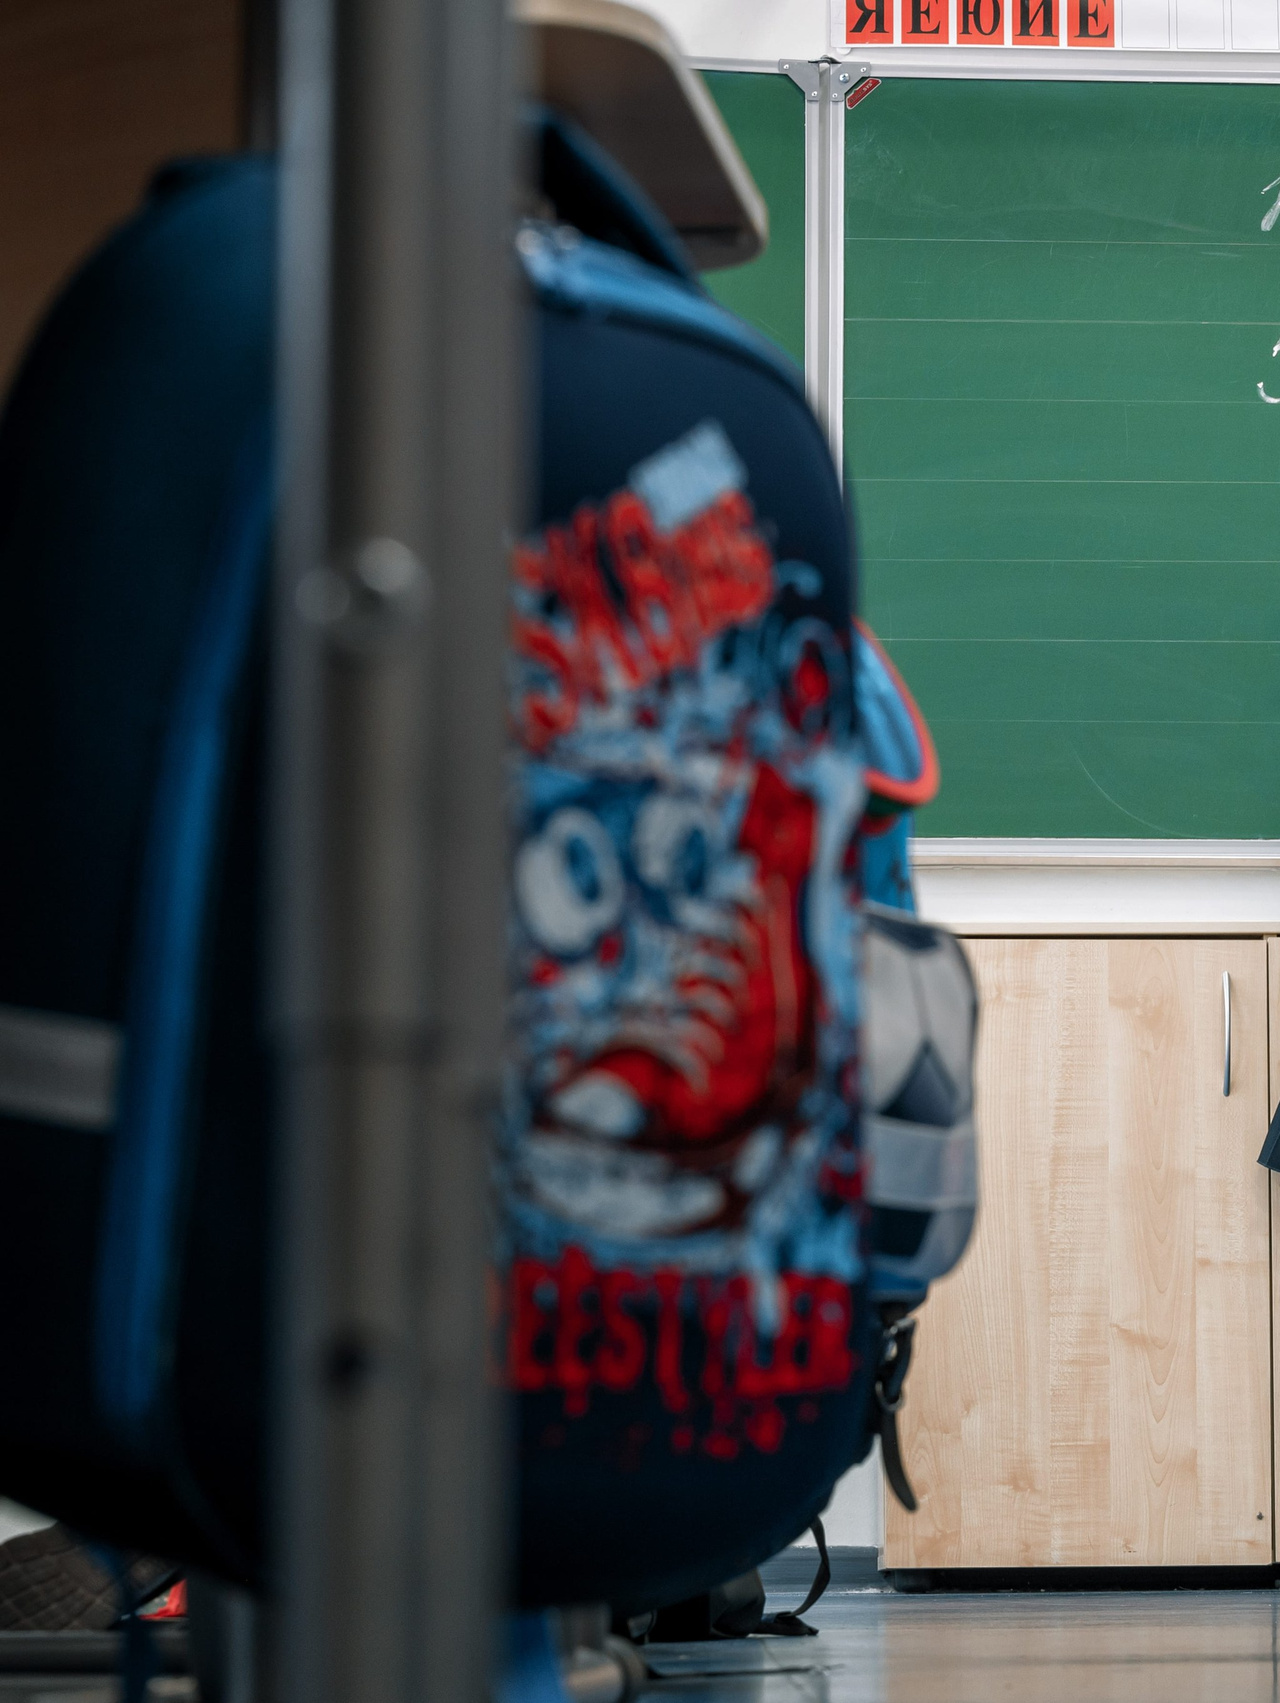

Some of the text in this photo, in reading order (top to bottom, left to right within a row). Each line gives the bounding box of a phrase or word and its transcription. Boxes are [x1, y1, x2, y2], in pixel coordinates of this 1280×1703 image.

[849, 0, 890, 34] Я
[959, 0, 1000, 36] Ю
[1073, 0, 1110, 39] Е
